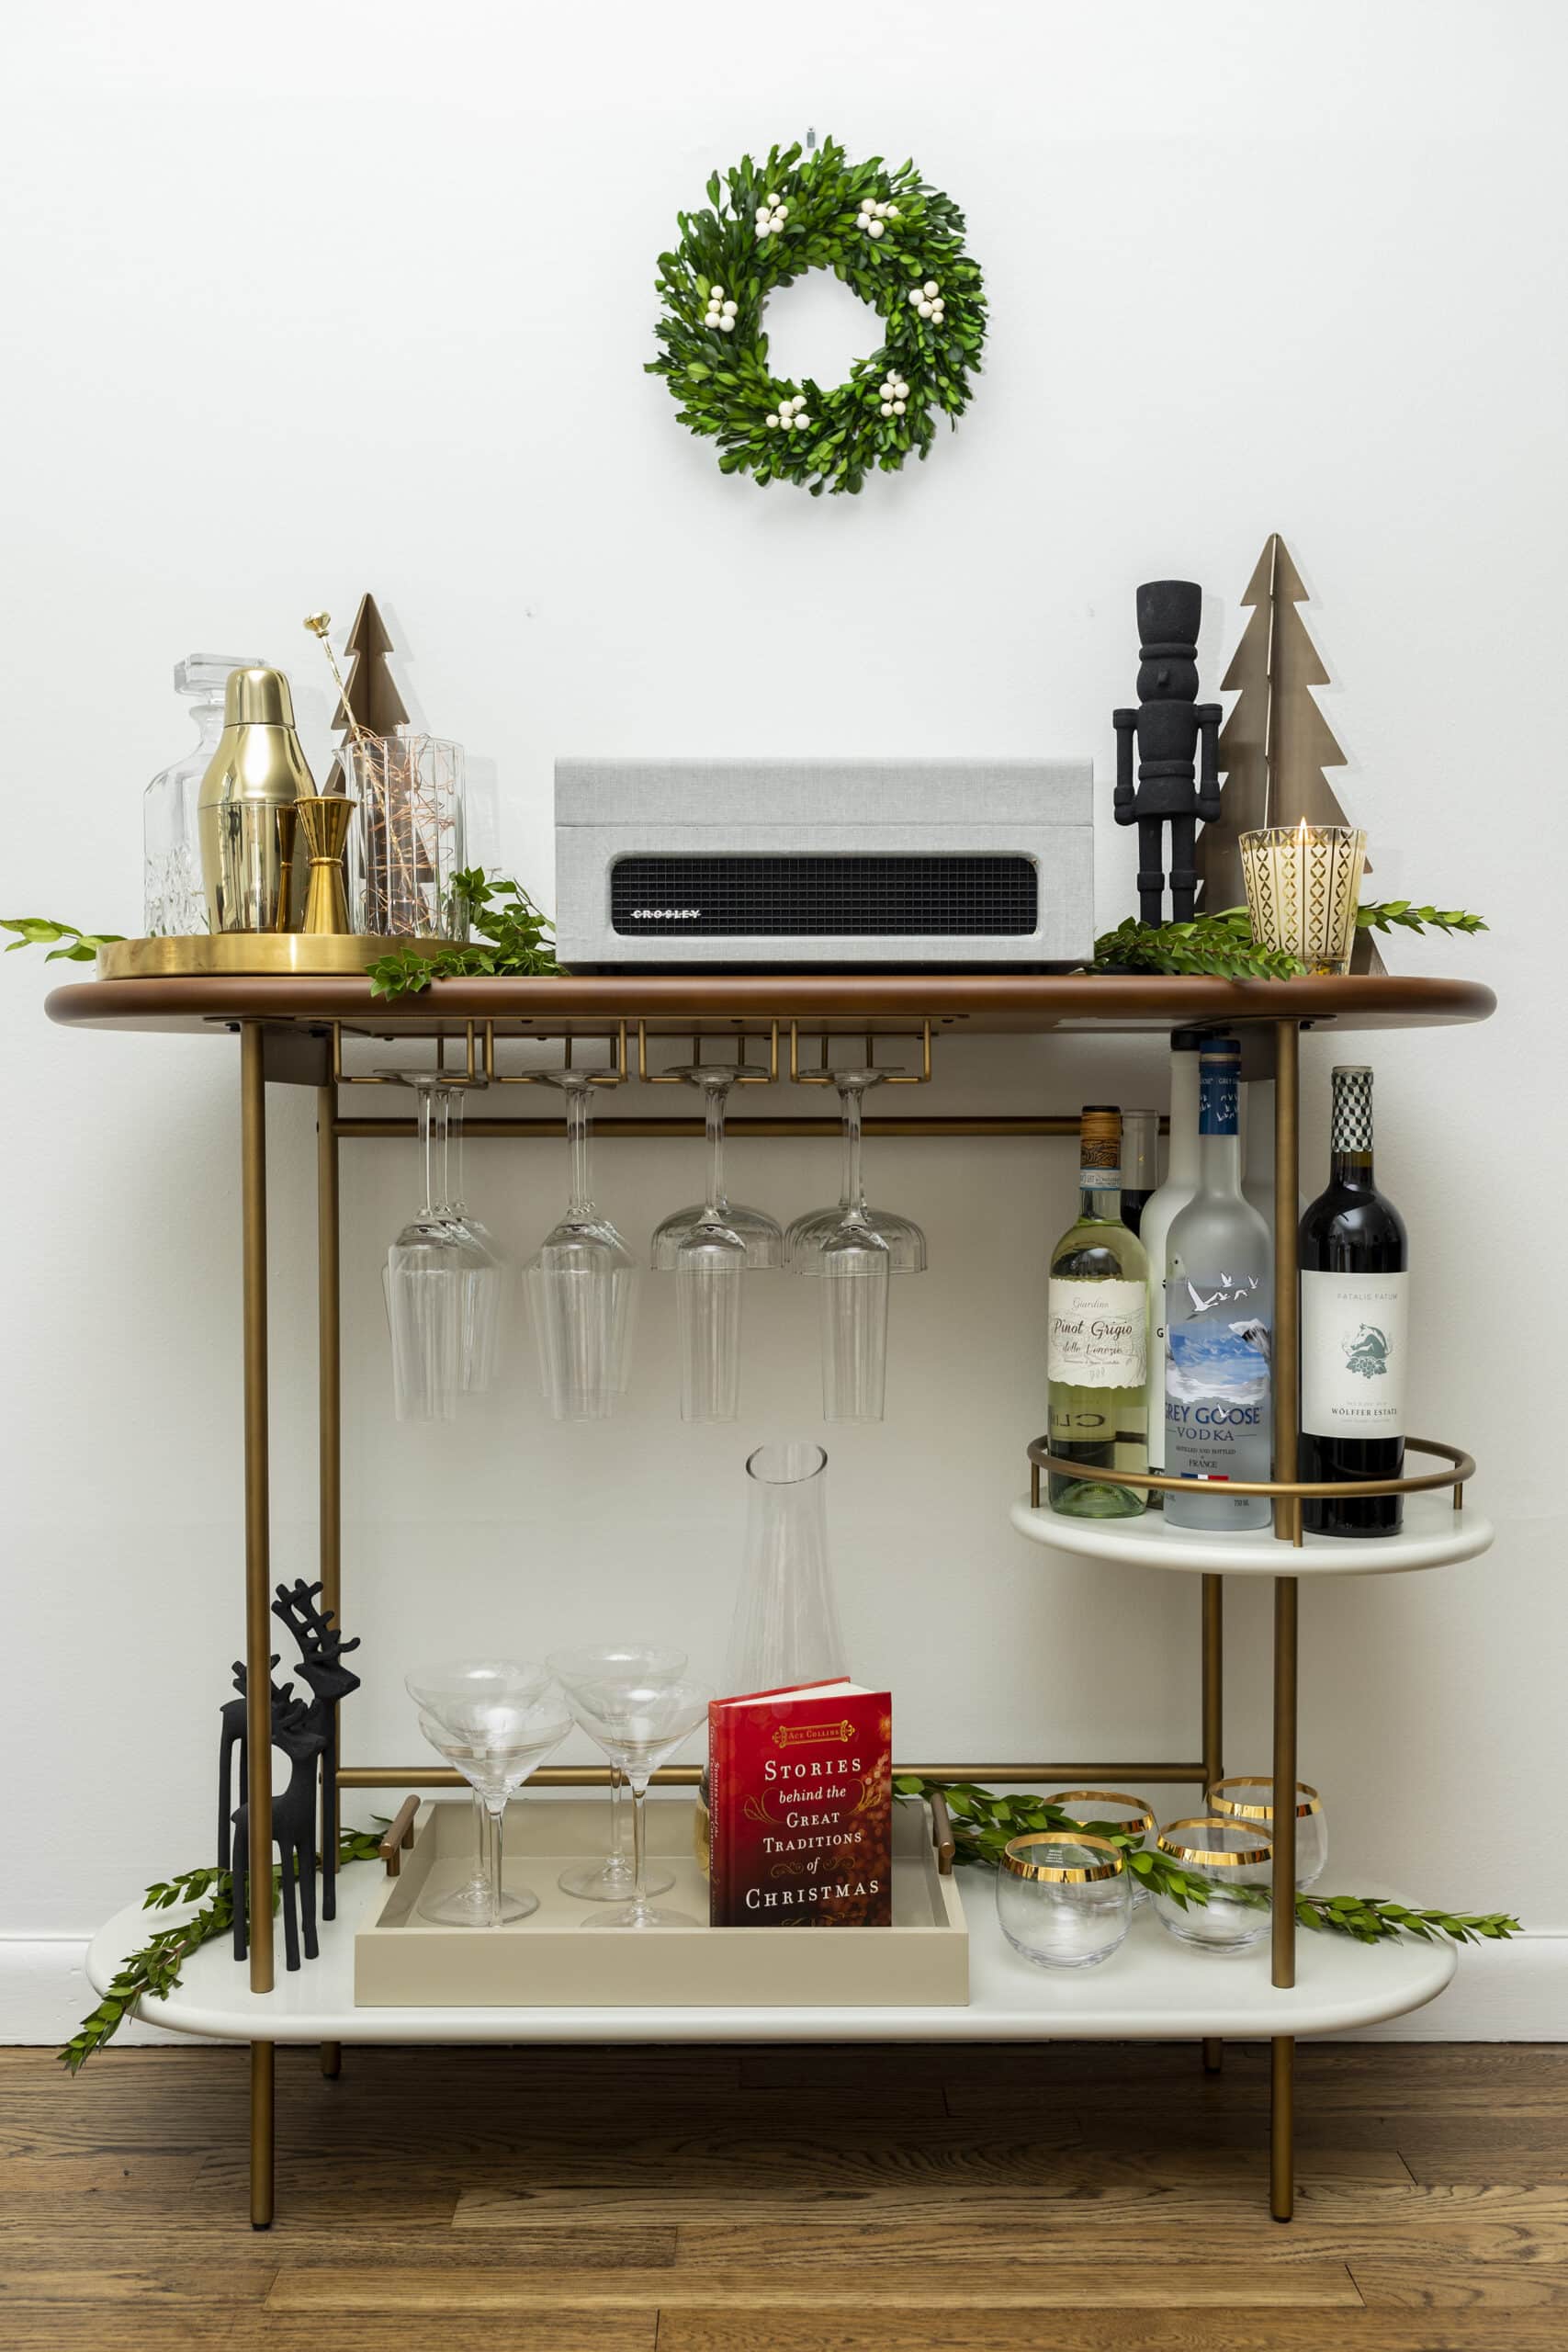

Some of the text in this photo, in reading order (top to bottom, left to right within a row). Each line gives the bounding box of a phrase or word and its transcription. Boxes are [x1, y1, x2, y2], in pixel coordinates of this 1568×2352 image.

[632, 910, 701, 919] CROSLEY
[1055, 1317, 1133, 1340] Pinot Grigio
[1195, 1407, 1260, 1425] GOOSE
[1177, 1427, 1235, 1441] VODKA
[1189, 1459, 1217, 1468] FRANCE
[788, 1729, 840, 1740] ACE COLLINS
[764, 1758, 861, 1781] STORIES
[779, 1785, 846, 1804] behind the
[786, 1812, 840, 1827] GREAT
[762, 1832, 862, 1853] TRADITIONS
[807, 1857, 820, 1874] of
[746, 1880, 879, 1909] CHRISTMAS
